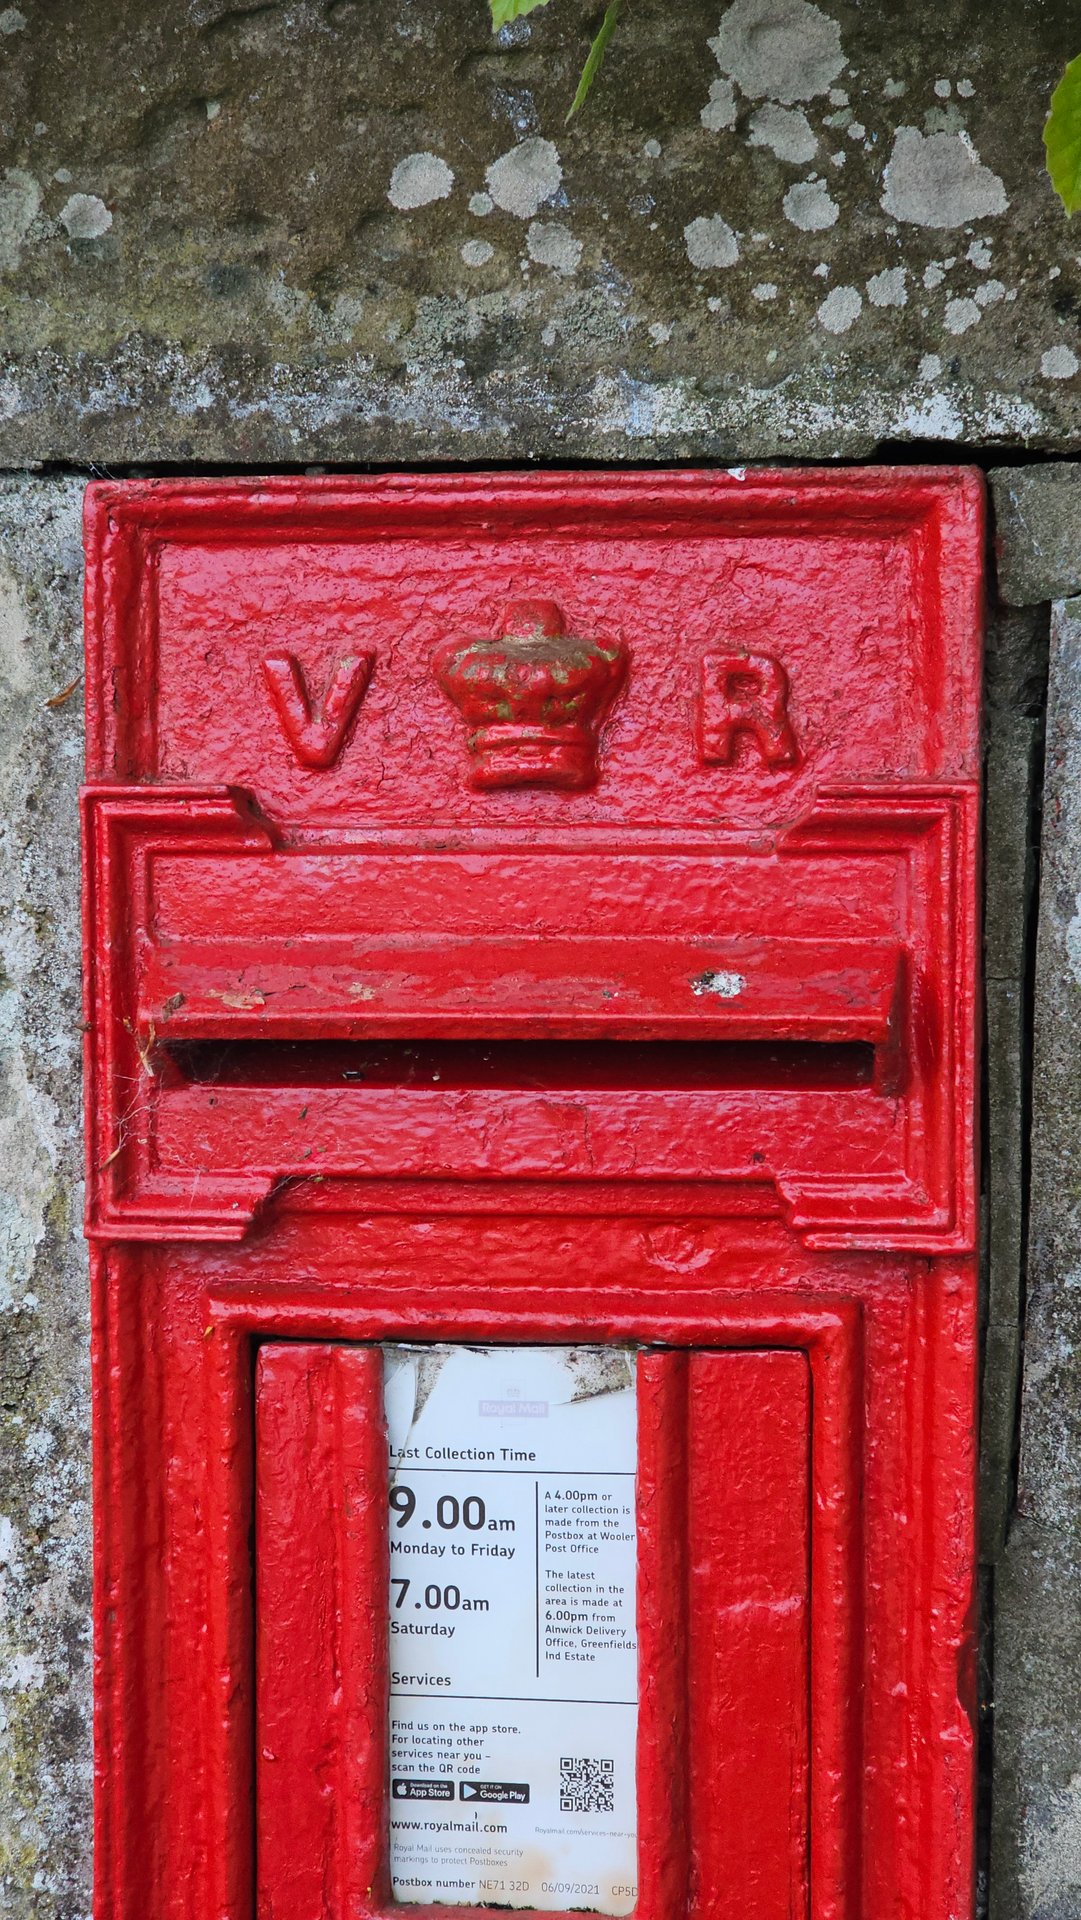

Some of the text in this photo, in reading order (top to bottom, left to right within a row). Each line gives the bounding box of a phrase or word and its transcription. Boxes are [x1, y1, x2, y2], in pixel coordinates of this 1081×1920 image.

[261, 647, 799, 771] V R
[482, 1403, 545, 1415] Royal Mail
[390, 1445, 535, 1461] Last Collection Time
[545, 1491, 551, 1499] A
[555, 1490, 597, 1502] 4.00pm
[388, 1485, 516, 1532] 9.00am
[545, 1505, 630, 1514] later collection is
[545, 1518, 619, 1527] made from the
[545, 1531, 583, 1539] Postbox
[600, 1532, 635, 1540] Wooler
[390, 1541, 515, 1559] Monday to Friday
[545, 1544, 599, 1553] Post Office
[545, 1570, 595, 1579] The latest
[545, 1584, 592, 1592] collection
[596, 1585, 604, 1593] in
[390, 1578, 490, 1611] 7.00am
[571, 1597, 578, 1605] is
[545, 1611, 615, 1622] 6.00pm from
[391, 1622, 455, 1637] Saturday
[545, 1625, 626, 1637] Alnwick Delivery
[545, 1638, 636, 1649] Office, Greenfields
[545, 1651, 595, 1661] Ind Estate
[391, 1672, 451, 1686] Services
[392, 1721, 521, 1734] Find us on the app store.
[392, 1735, 484, 1747] For locating other
[392, 1750, 433, 1758] services
[437, 1751, 461, 1760] near
[463, 1752, 482, 1761] you
[392, 1764, 481, 1774] scan the QR code
[428, 1789, 450, 1797] Store
[480, 1790, 525, 1801] Google Play
[392, 1820, 508, 1833] www.royalmail.com
[394, 1844, 414, 1852] Royal
[494, 1848, 523, 1858] security
[394, 1856, 428, 1864] markings
[441, 1857, 467, 1865] protect
[470, 1858, 508, 1866] Postboxes
[393, 1877, 432, 1886] Postbox
[436, 1879, 476, 1888] number
[479, 1880, 505, 1890] NE71
[509, 1881, 530, 1891] 32D
[541, 1882, 599, 1895] 06/09/2021
